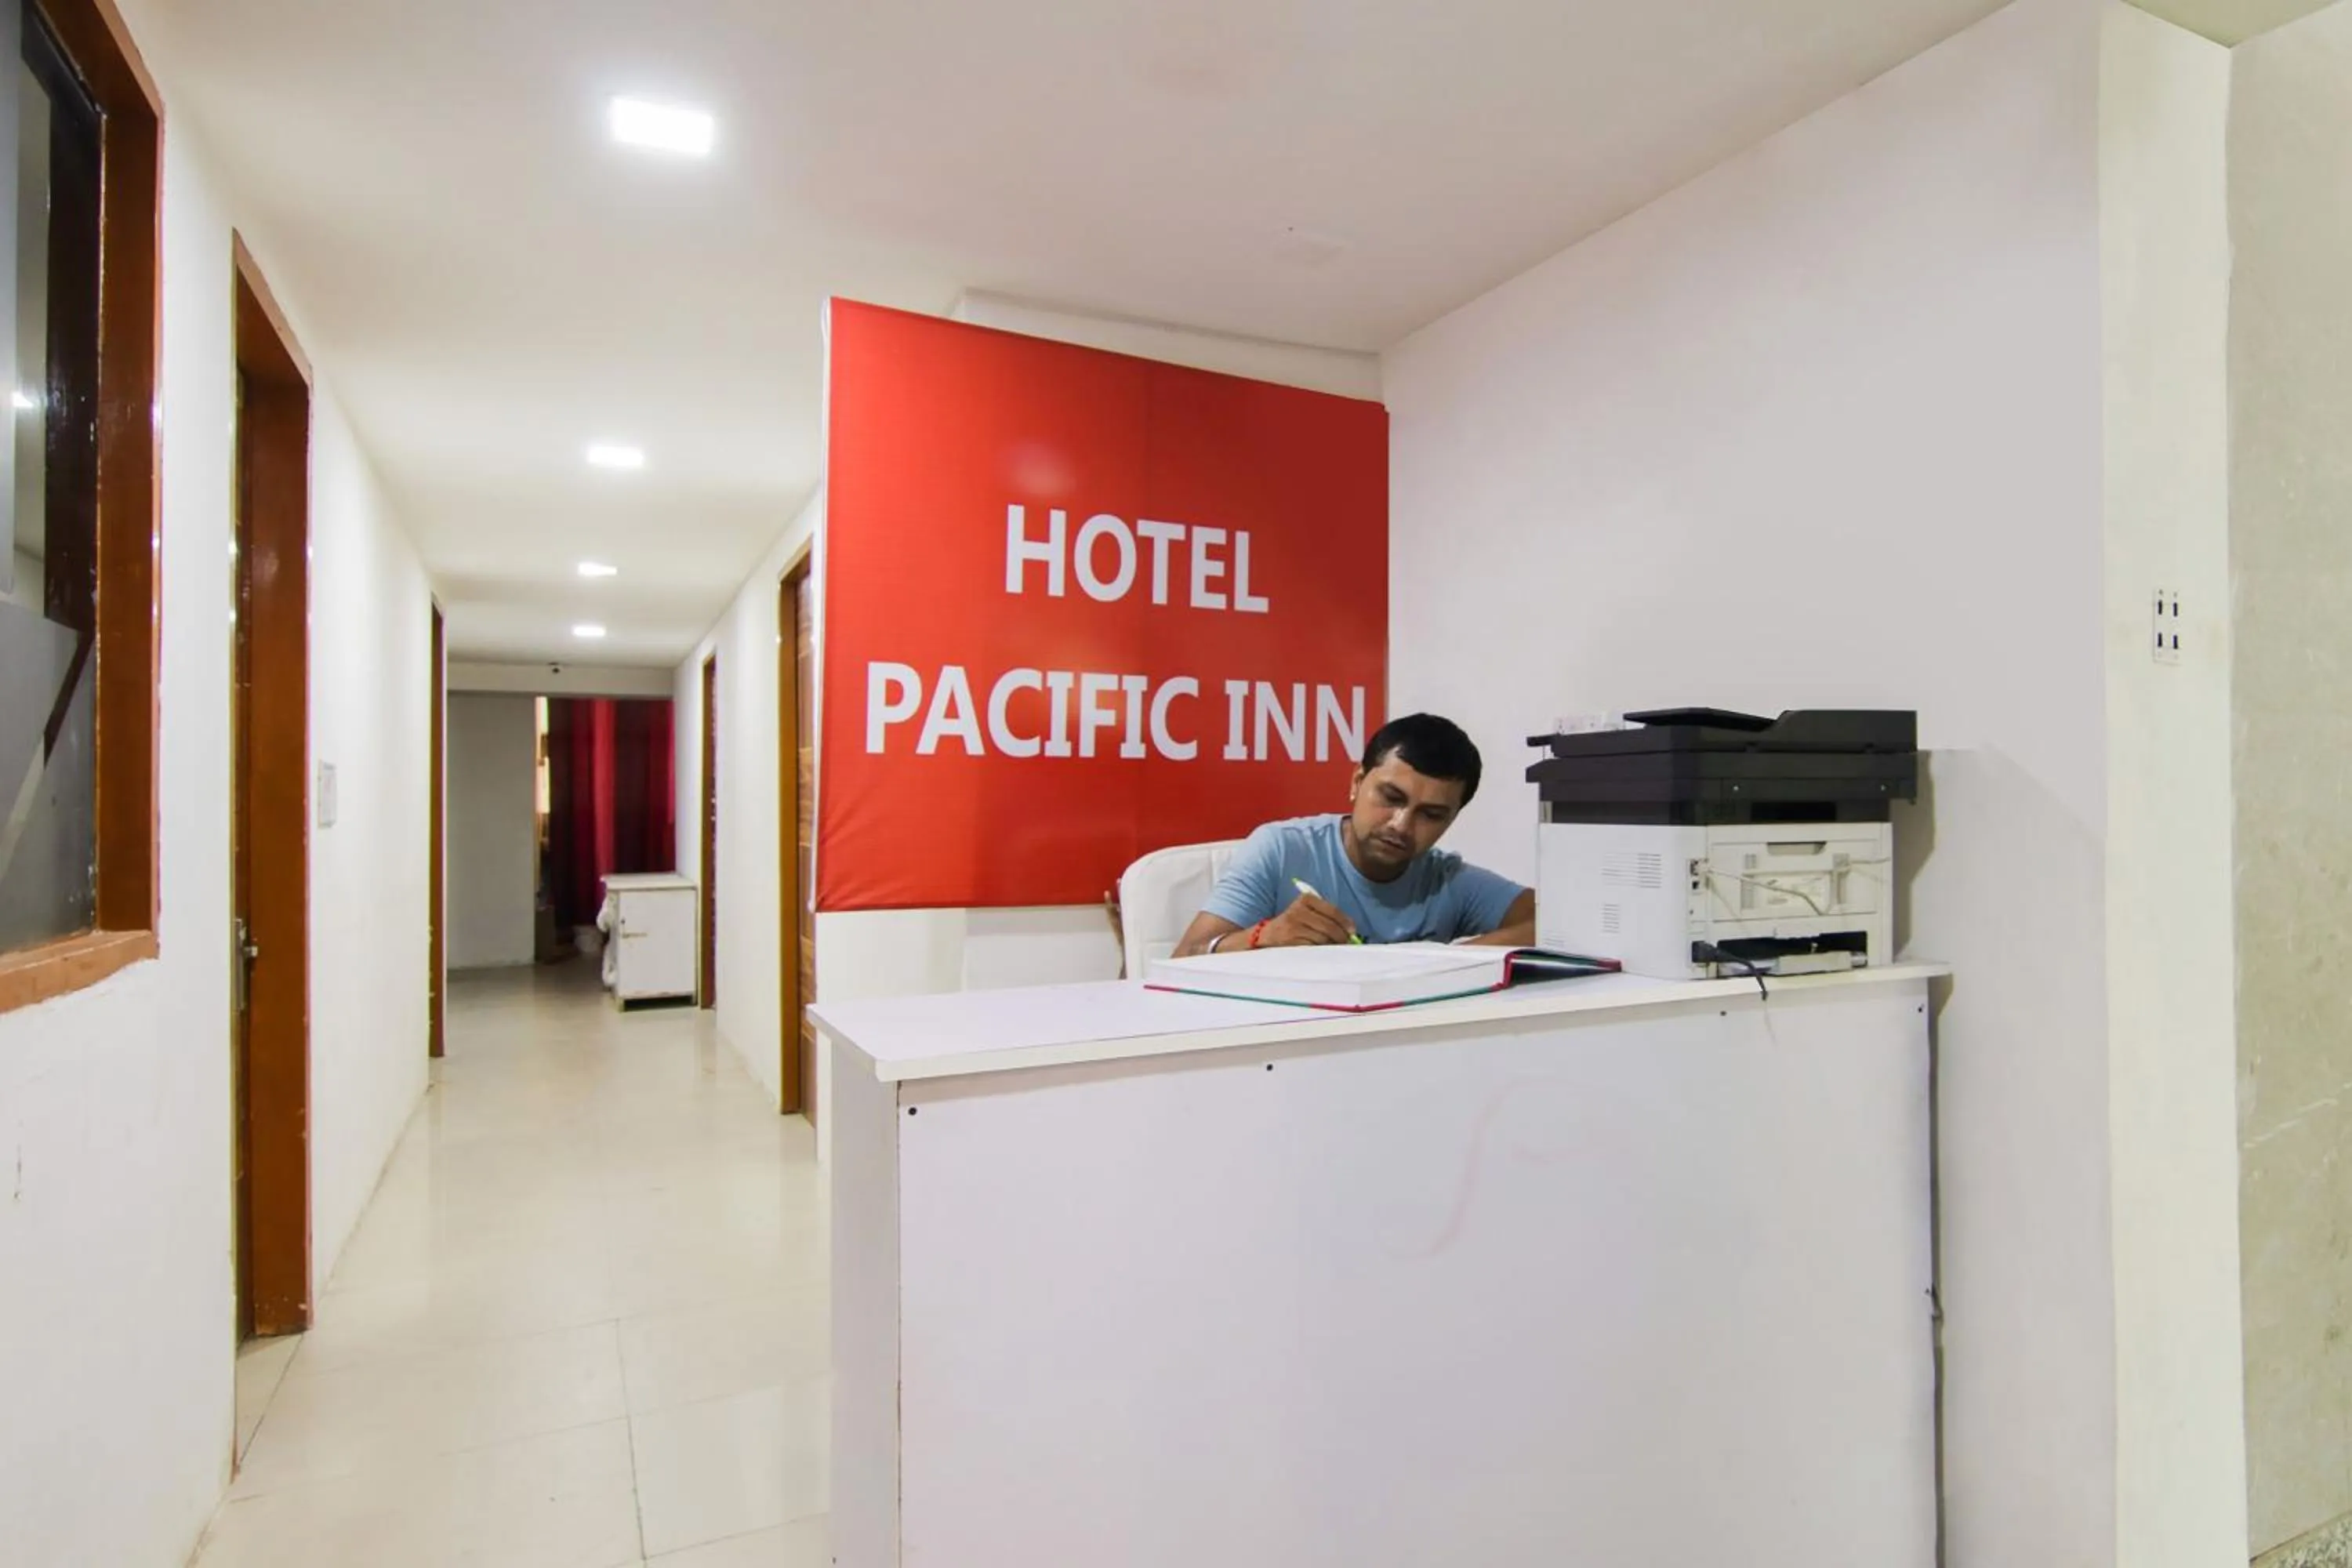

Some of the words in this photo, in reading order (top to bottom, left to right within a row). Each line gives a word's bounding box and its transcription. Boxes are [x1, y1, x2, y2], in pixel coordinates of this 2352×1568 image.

[1005, 504, 1269, 613] HOTEL
[866, 661, 1199, 760] PACIFIC
[1223, 679, 1365, 762] INN
